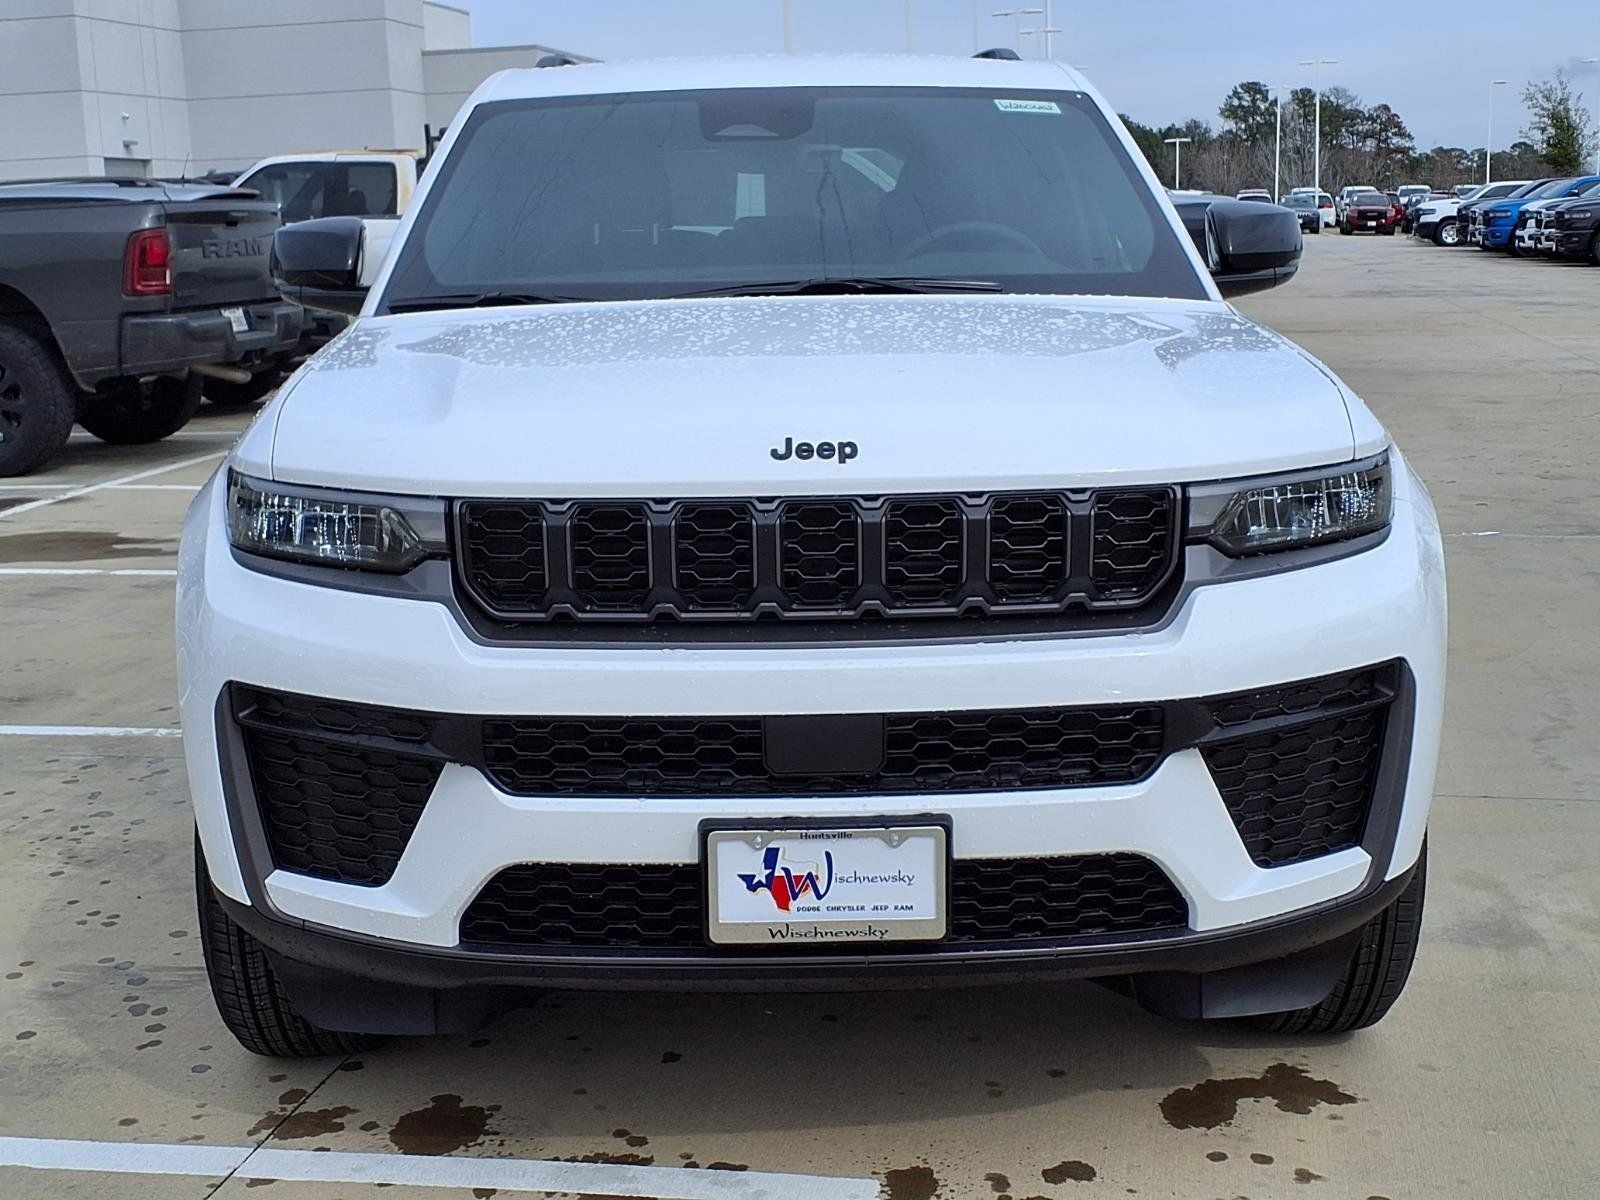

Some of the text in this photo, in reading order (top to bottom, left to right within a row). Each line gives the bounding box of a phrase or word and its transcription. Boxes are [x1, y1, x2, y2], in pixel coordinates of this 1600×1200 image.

[202, 239, 265, 259] RAM
[770, 437, 858, 464] Jeep
[800, 832, 852, 840] Huntsville
[781, 850, 915, 901] Wischnewsky
[768, 923, 889, 939] Wischnewsky
